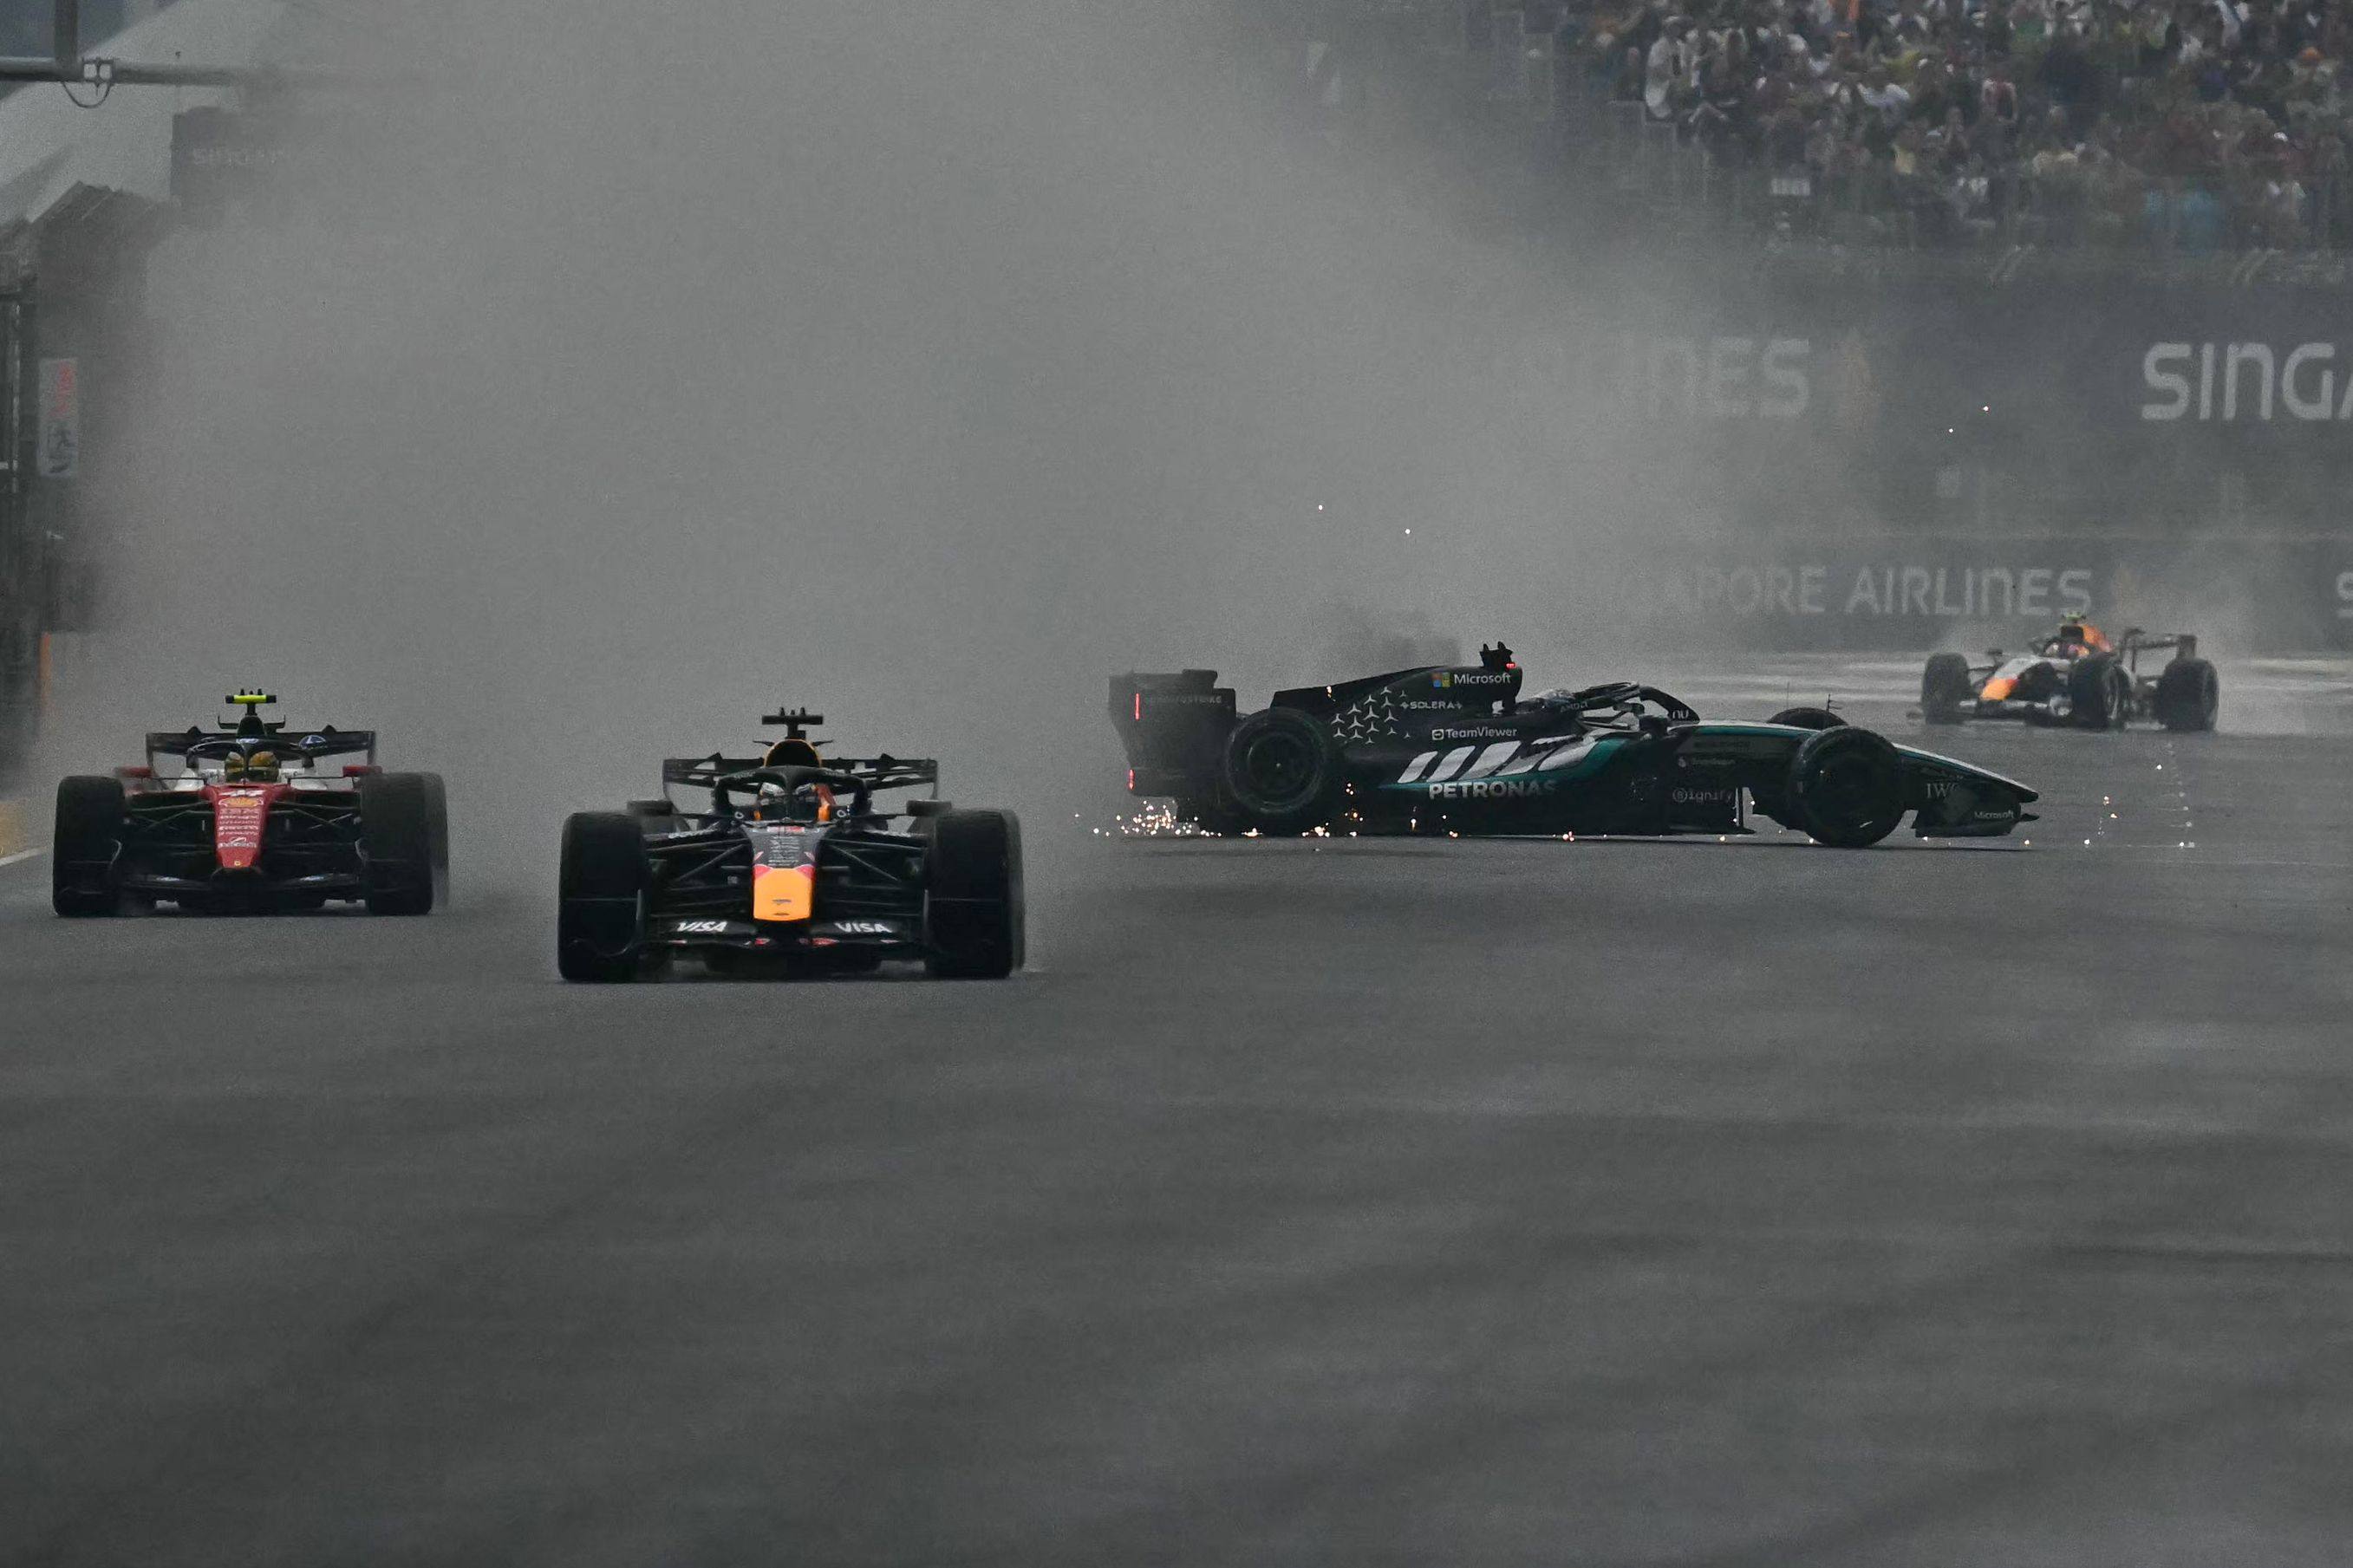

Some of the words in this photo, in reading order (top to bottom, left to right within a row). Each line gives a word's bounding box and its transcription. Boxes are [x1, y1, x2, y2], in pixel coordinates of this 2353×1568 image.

[1453, 673, 1512, 685] Microsoft
[1410, 701, 1455, 710] SOLERA
[1445, 726, 1518, 738] TeamViewer
[1428, 779, 1558, 800] PETRONAS
[1973, 810, 2014, 820] Microsoft
[676, 921, 727, 933] VISA
[833, 921, 893, 934] VISA
